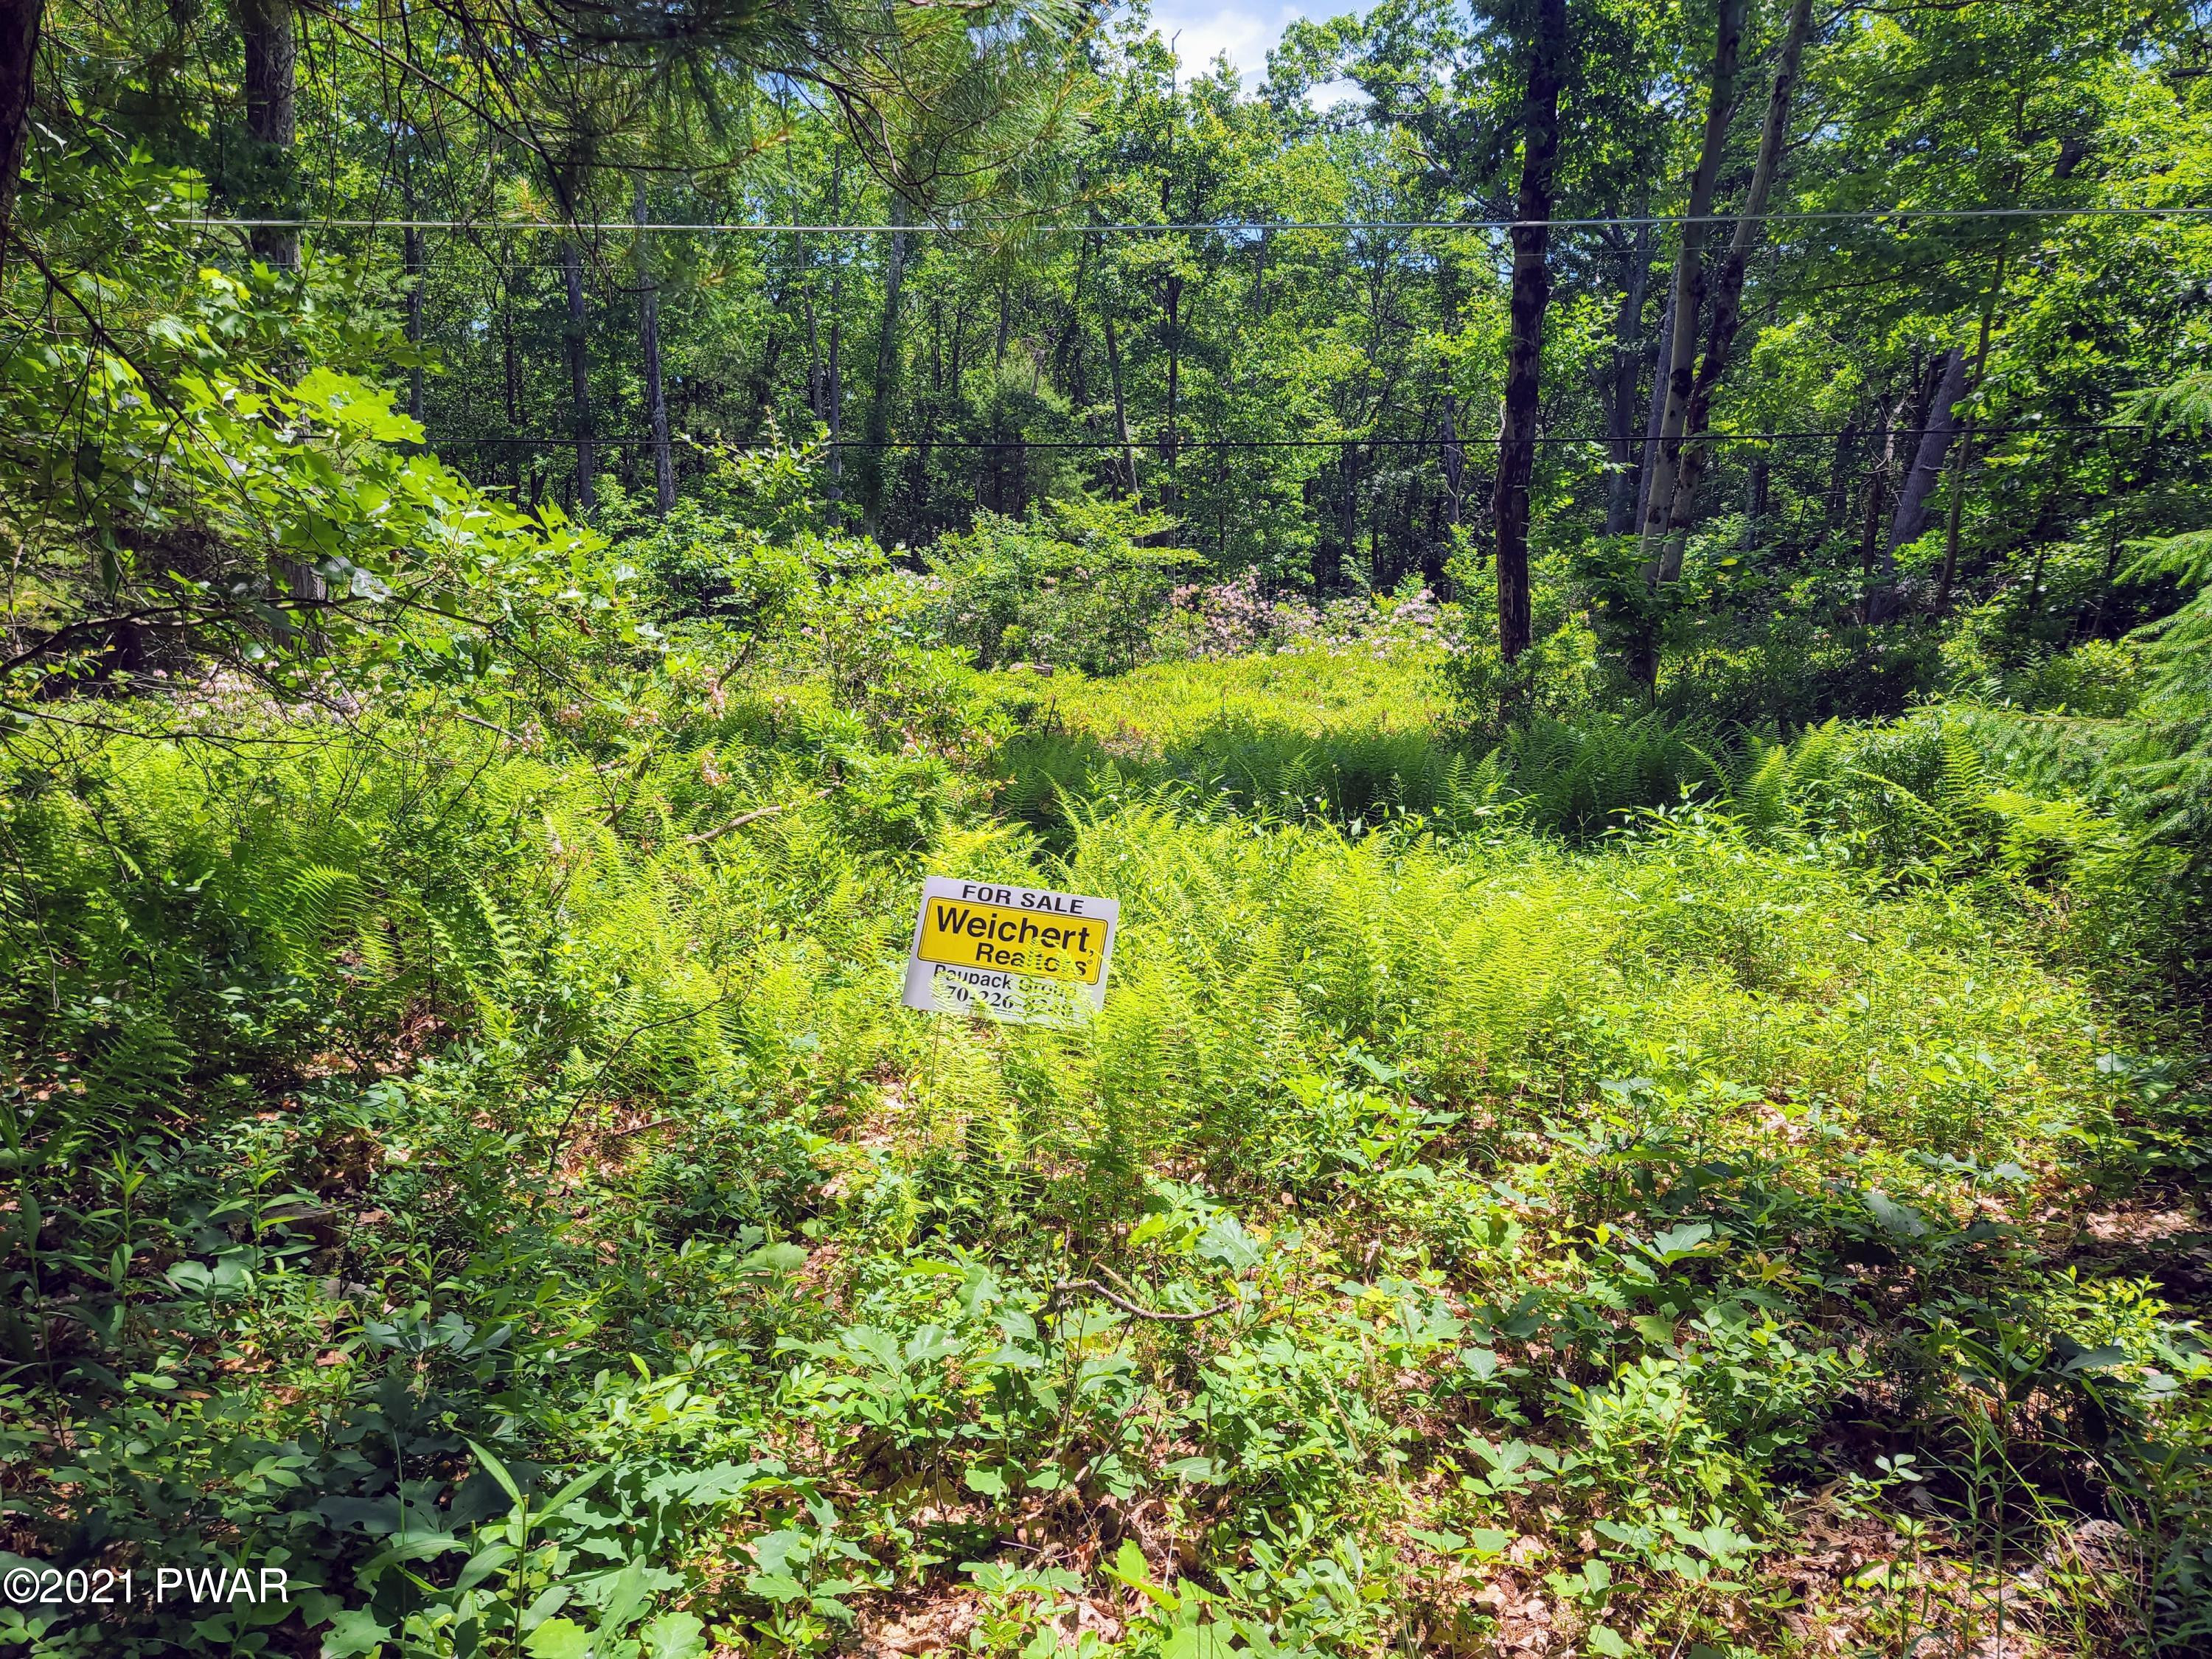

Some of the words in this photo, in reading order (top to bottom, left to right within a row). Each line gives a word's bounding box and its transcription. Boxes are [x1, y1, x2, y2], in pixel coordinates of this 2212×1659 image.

[962, 885, 1011, 905] FOR
[1020, 893, 1085, 914] SALE
[937, 905, 1095, 956] Weichert,
